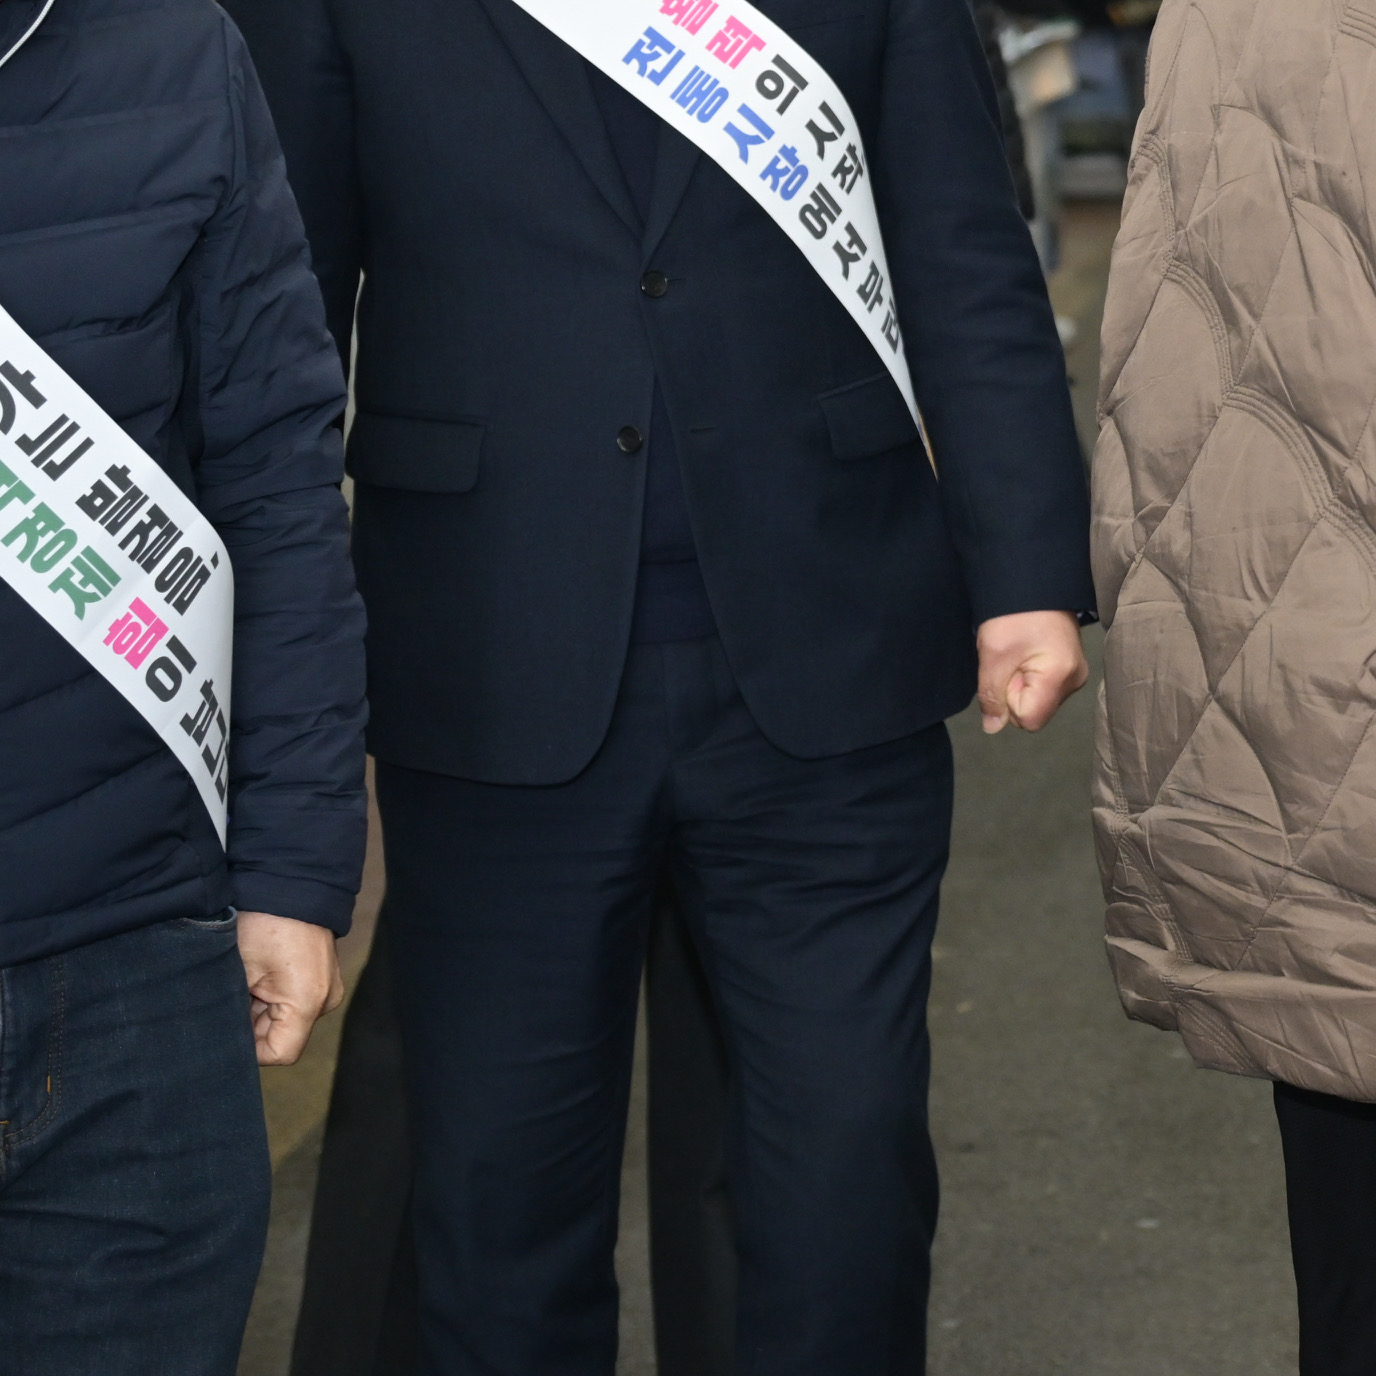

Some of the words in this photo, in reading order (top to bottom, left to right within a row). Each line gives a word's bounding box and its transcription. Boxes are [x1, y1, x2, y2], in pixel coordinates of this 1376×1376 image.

[804, 100, 867, 195] 시작
[75, 463, 220, 617] 발걸음,
[101, 596, 199, 704] 힘이
